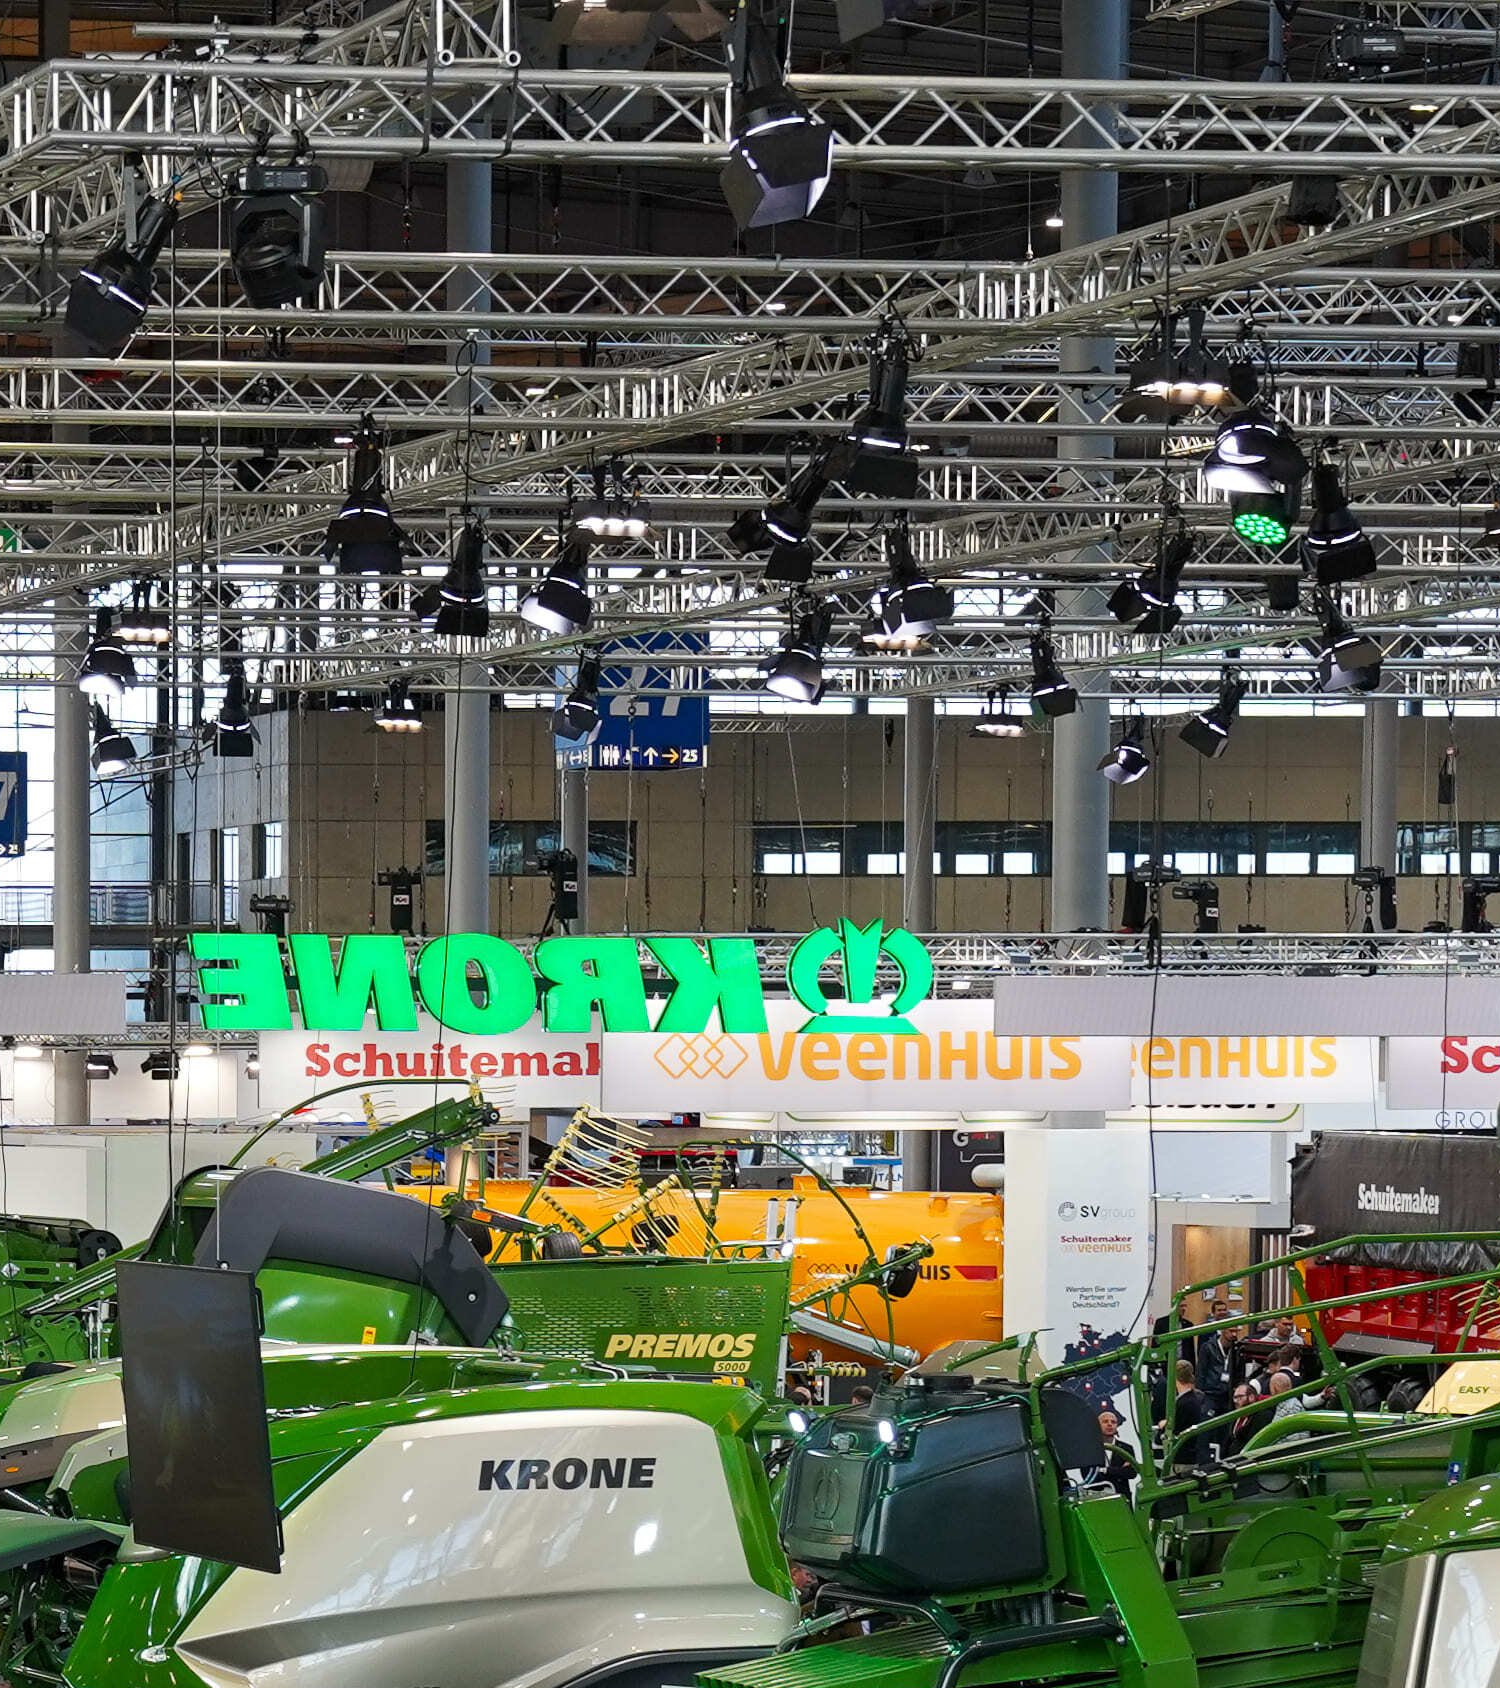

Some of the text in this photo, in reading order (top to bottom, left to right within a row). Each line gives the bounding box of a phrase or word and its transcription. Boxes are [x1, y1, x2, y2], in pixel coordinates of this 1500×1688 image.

[682, 749, 699, 763] 25
[1435, 1111, 1500, 1130] GROU
[1357, 1184, 1440, 1215] Schuitemaker
[1061, 1235, 1132, 1243] Schuitemaker
[604, 1333, 756, 1359] PREMOS
[716, 1361, 749, 1373] 5000
[478, 1456, 657, 1491] KRONE
